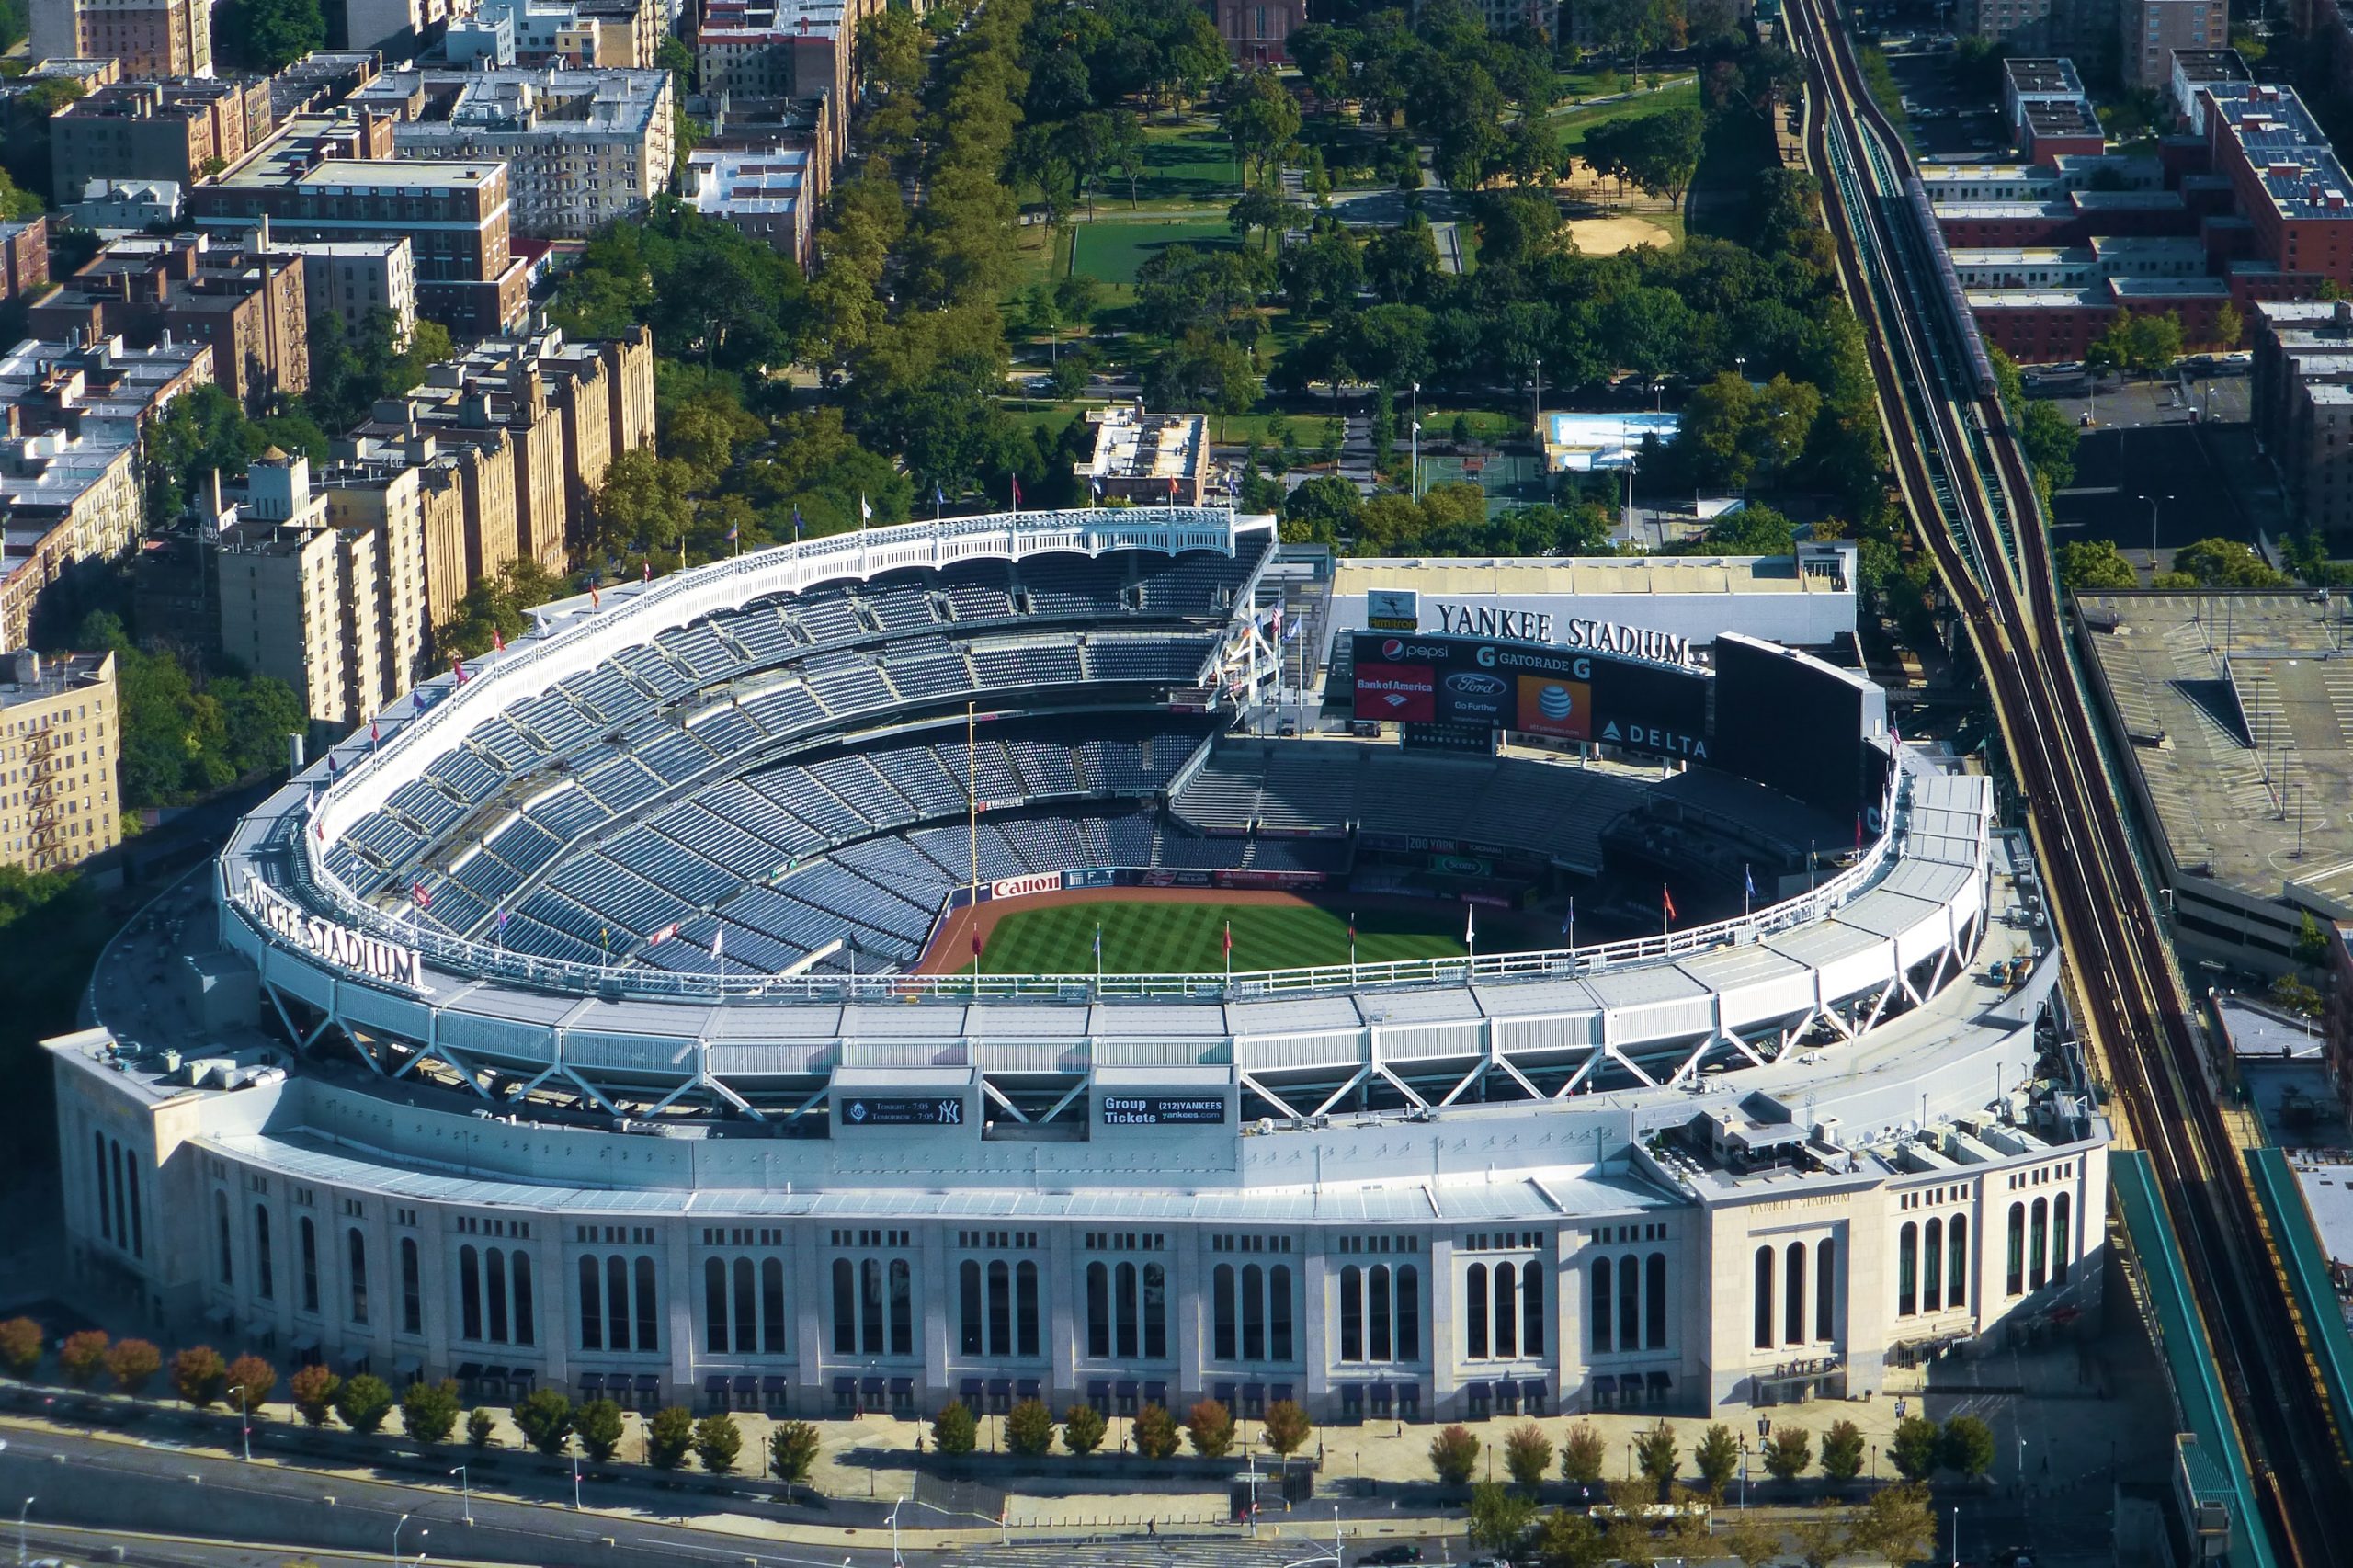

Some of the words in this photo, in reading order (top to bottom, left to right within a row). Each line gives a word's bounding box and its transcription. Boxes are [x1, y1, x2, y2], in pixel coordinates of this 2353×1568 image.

[1370, 618, 1416, 629] Armitron
[1436, 604, 1553, 642] YANKEE
[1567, 618, 1689, 666] STADIUM
[1406, 645, 1449, 659] pepsi
[1499, 653, 1569, 671] GATORADE
[1358, 679, 1381, 689] Bank
[1382, 679, 1394, 690] of
[1394, 681, 1433, 692] America
[1457, 677, 1495, 694] Ford
[1454, 701, 1471, 710] Go
[1470, 702, 1497, 713] Further
[1630, 724, 1708, 759] DELTA
[1409, 837, 1428, 850] ZOO
[1430, 838, 1456, 851] YORK
[993, 876, 1060, 897] Canon
[306, 915, 425, 987] STADIUM
[1105, 1098, 1147, 1111] Group
[1159, 1102, 1222, 1110] (212)YANKEES
[1105, 1112, 1156, 1123] Tickets
[1162, 1111, 1221, 1119] yankees.com
[1800, 1192, 1850, 1208] STADIUM
[1775, 1358, 1818, 1378] GATE
